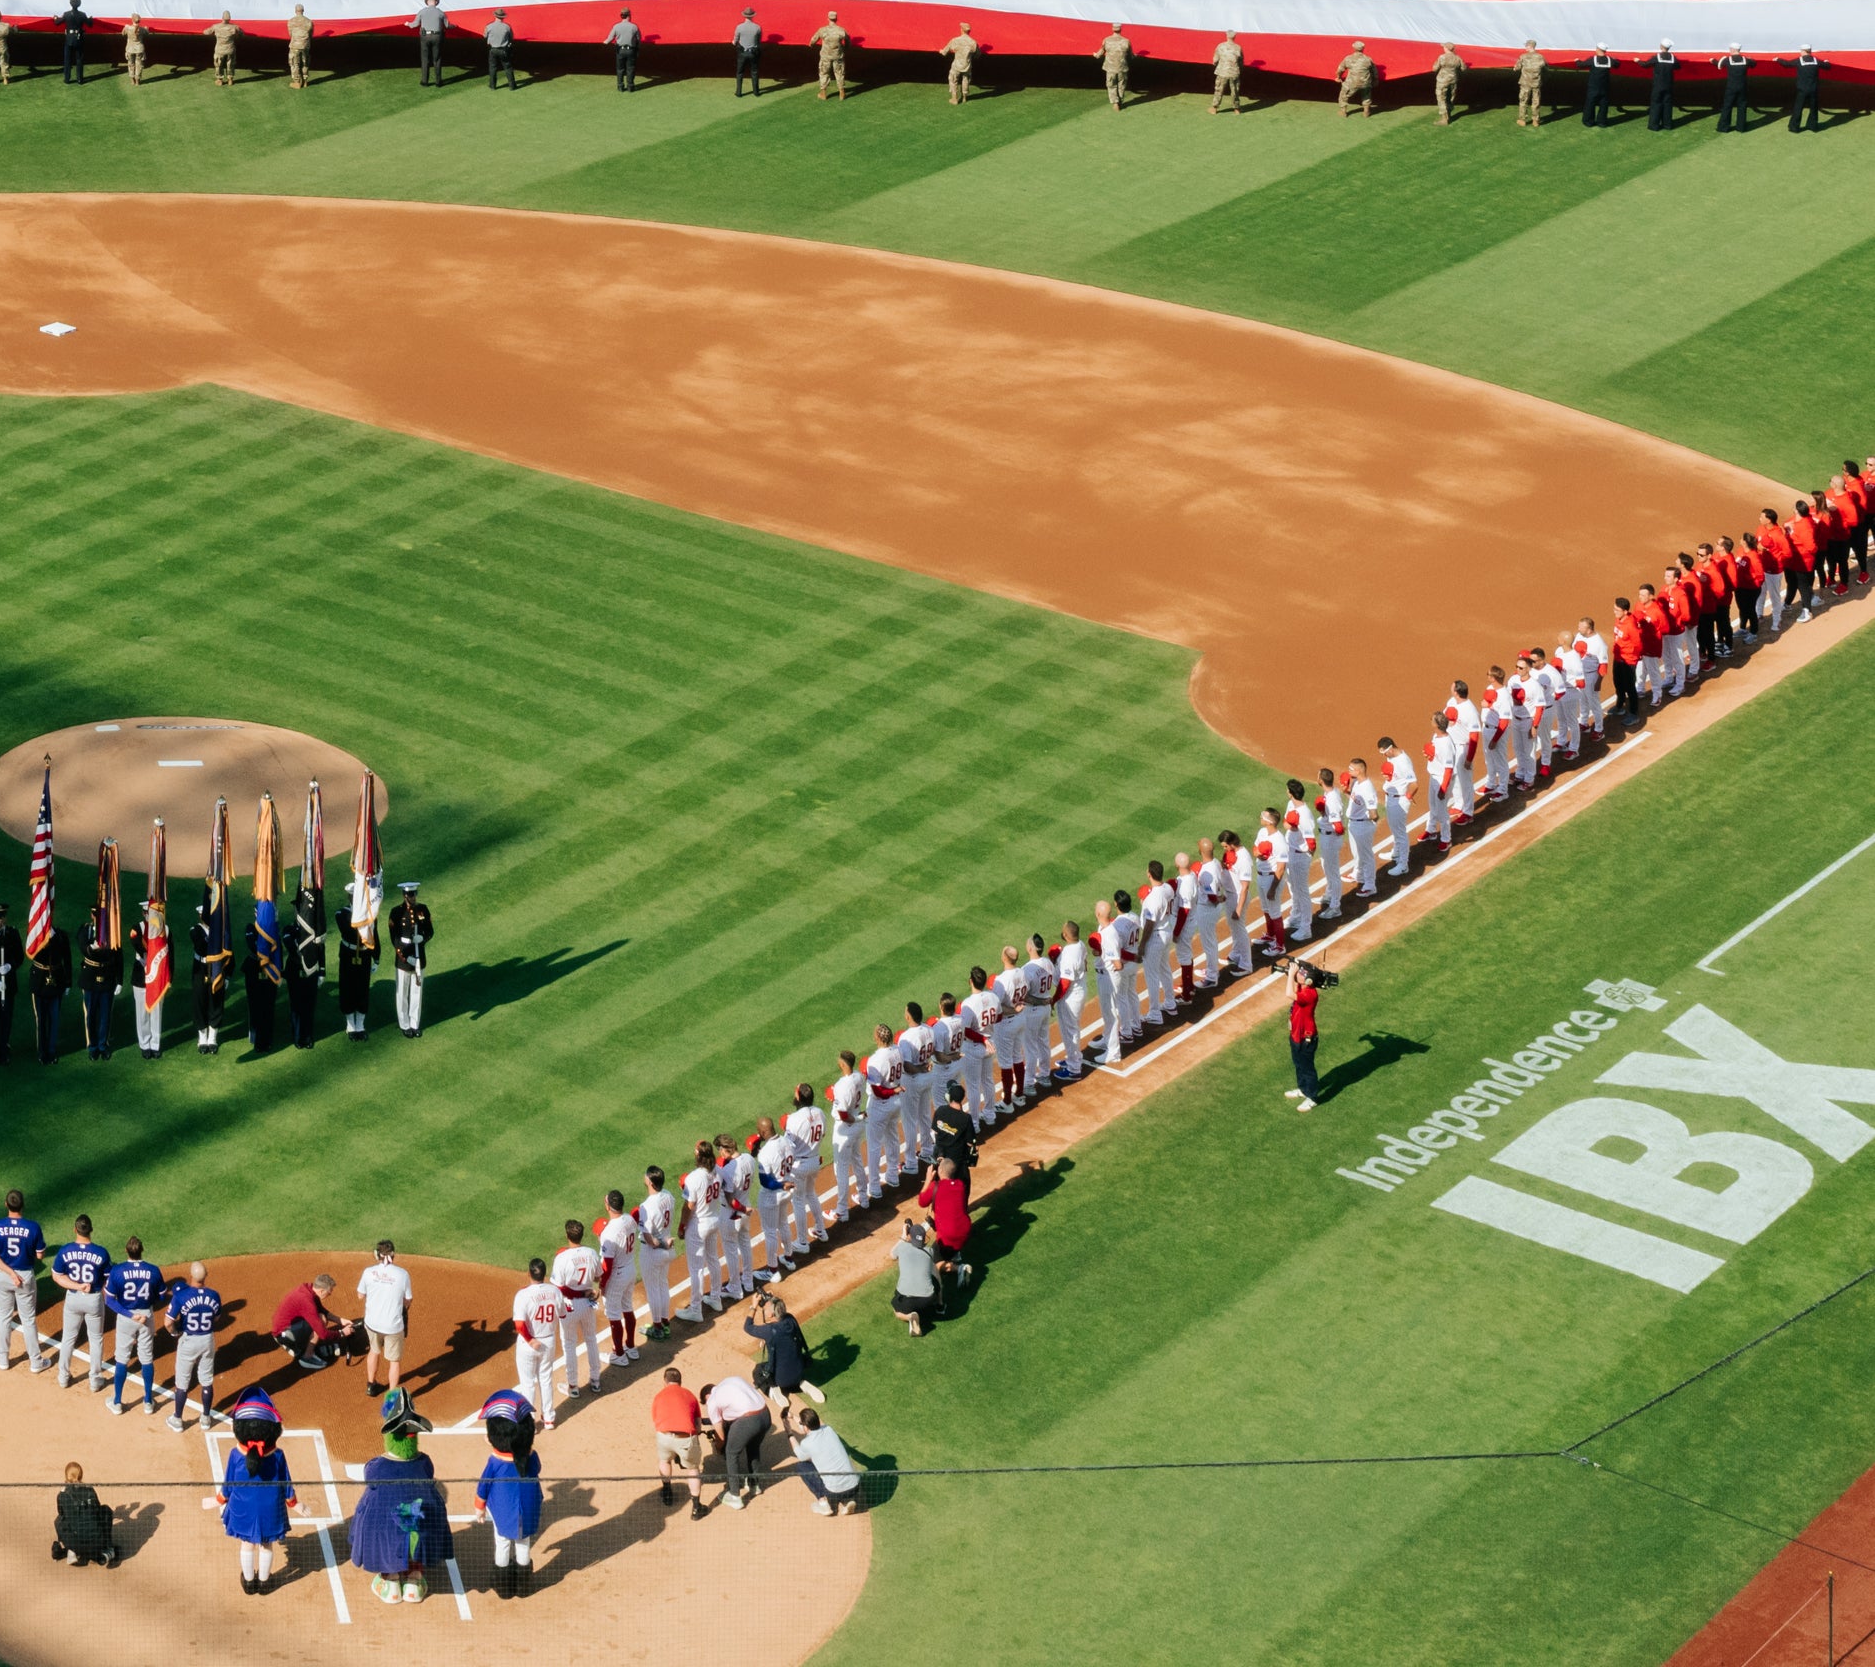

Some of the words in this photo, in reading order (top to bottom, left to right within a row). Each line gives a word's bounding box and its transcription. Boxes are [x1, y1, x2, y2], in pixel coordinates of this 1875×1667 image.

[1335, 1009, 1618, 1194] Independence
[1429, 1003, 1875, 1294] IBX
[7, 1238, 20, 1257] 5
[62, 1252, 103, 1266] LANGFORD
[68, 1263, 94, 1284] 36
[123, 1270, 151, 1281] NIMMO
[577, 1267, 588, 1286] 7
[124, 1281, 150, 1301] 24
[186, 1312, 213, 1332] 55
[534, 1304, 555, 1324] 49
